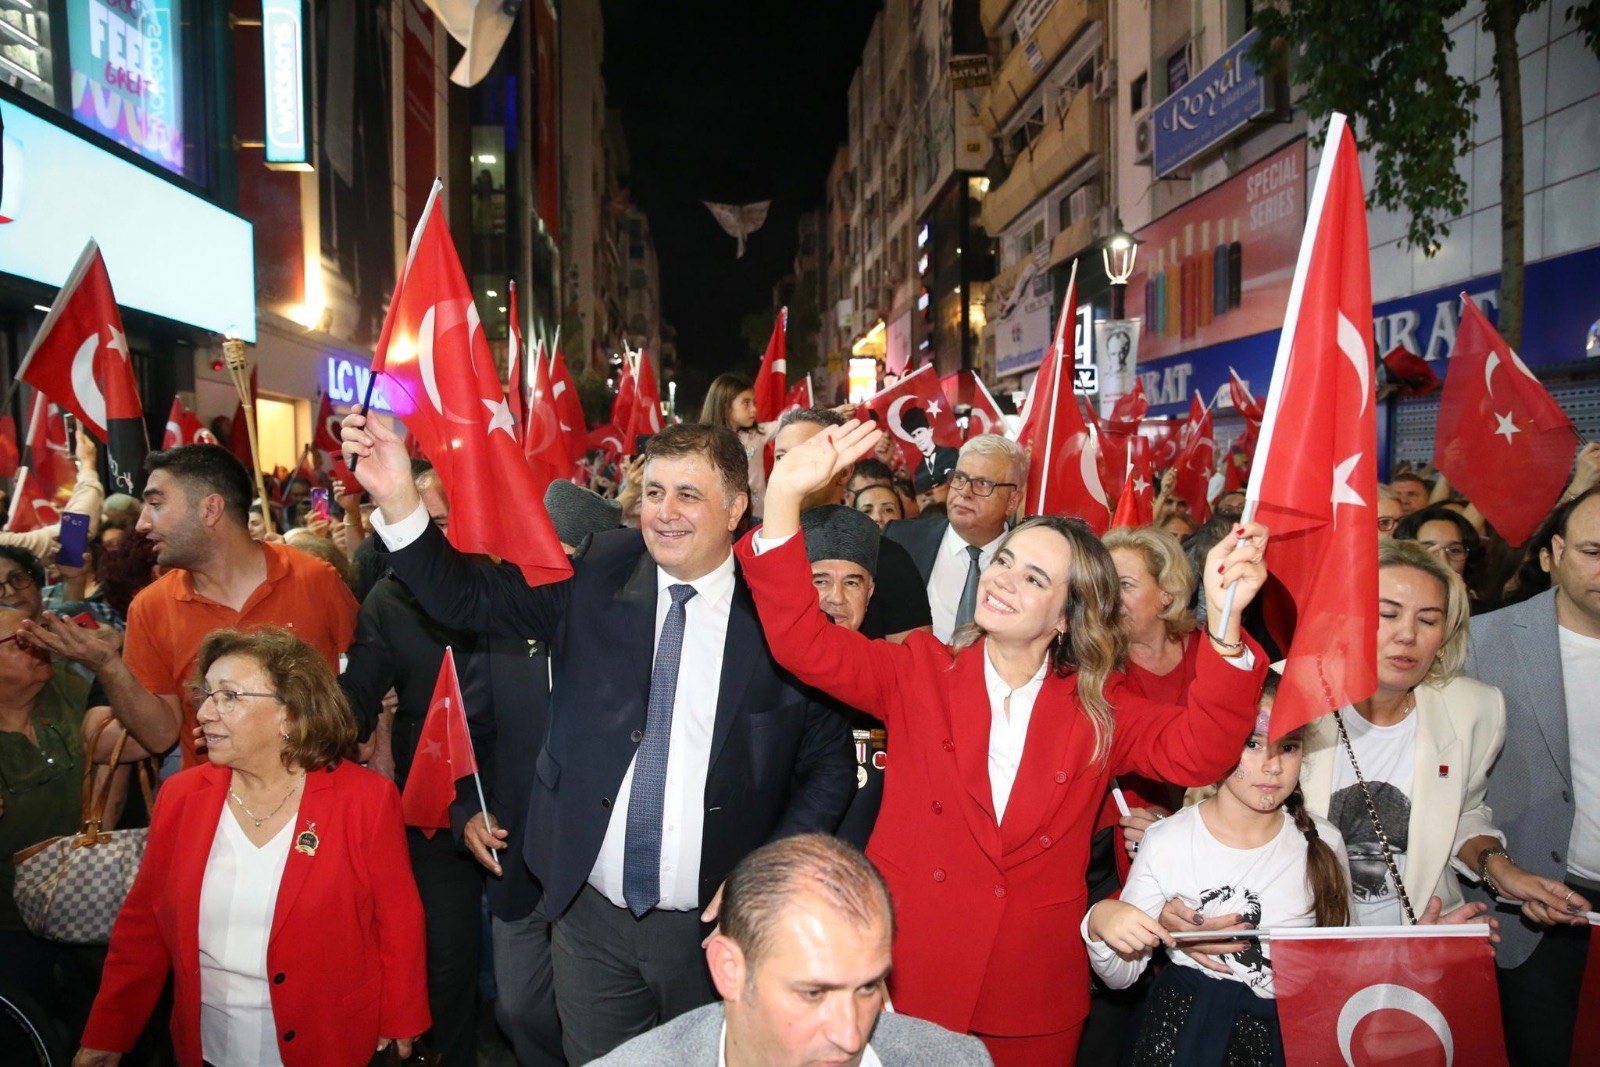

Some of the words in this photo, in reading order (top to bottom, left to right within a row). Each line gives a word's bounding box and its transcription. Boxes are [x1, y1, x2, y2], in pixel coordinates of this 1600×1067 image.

[104, 60, 152, 97] GREAT
[1163, 50, 1244, 132] Royal
[1246, 153, 1300, 203] SPECIAL
[1250, 186, 1295, 231] SERIES
[1142, 362, 1193, 406] RAT
